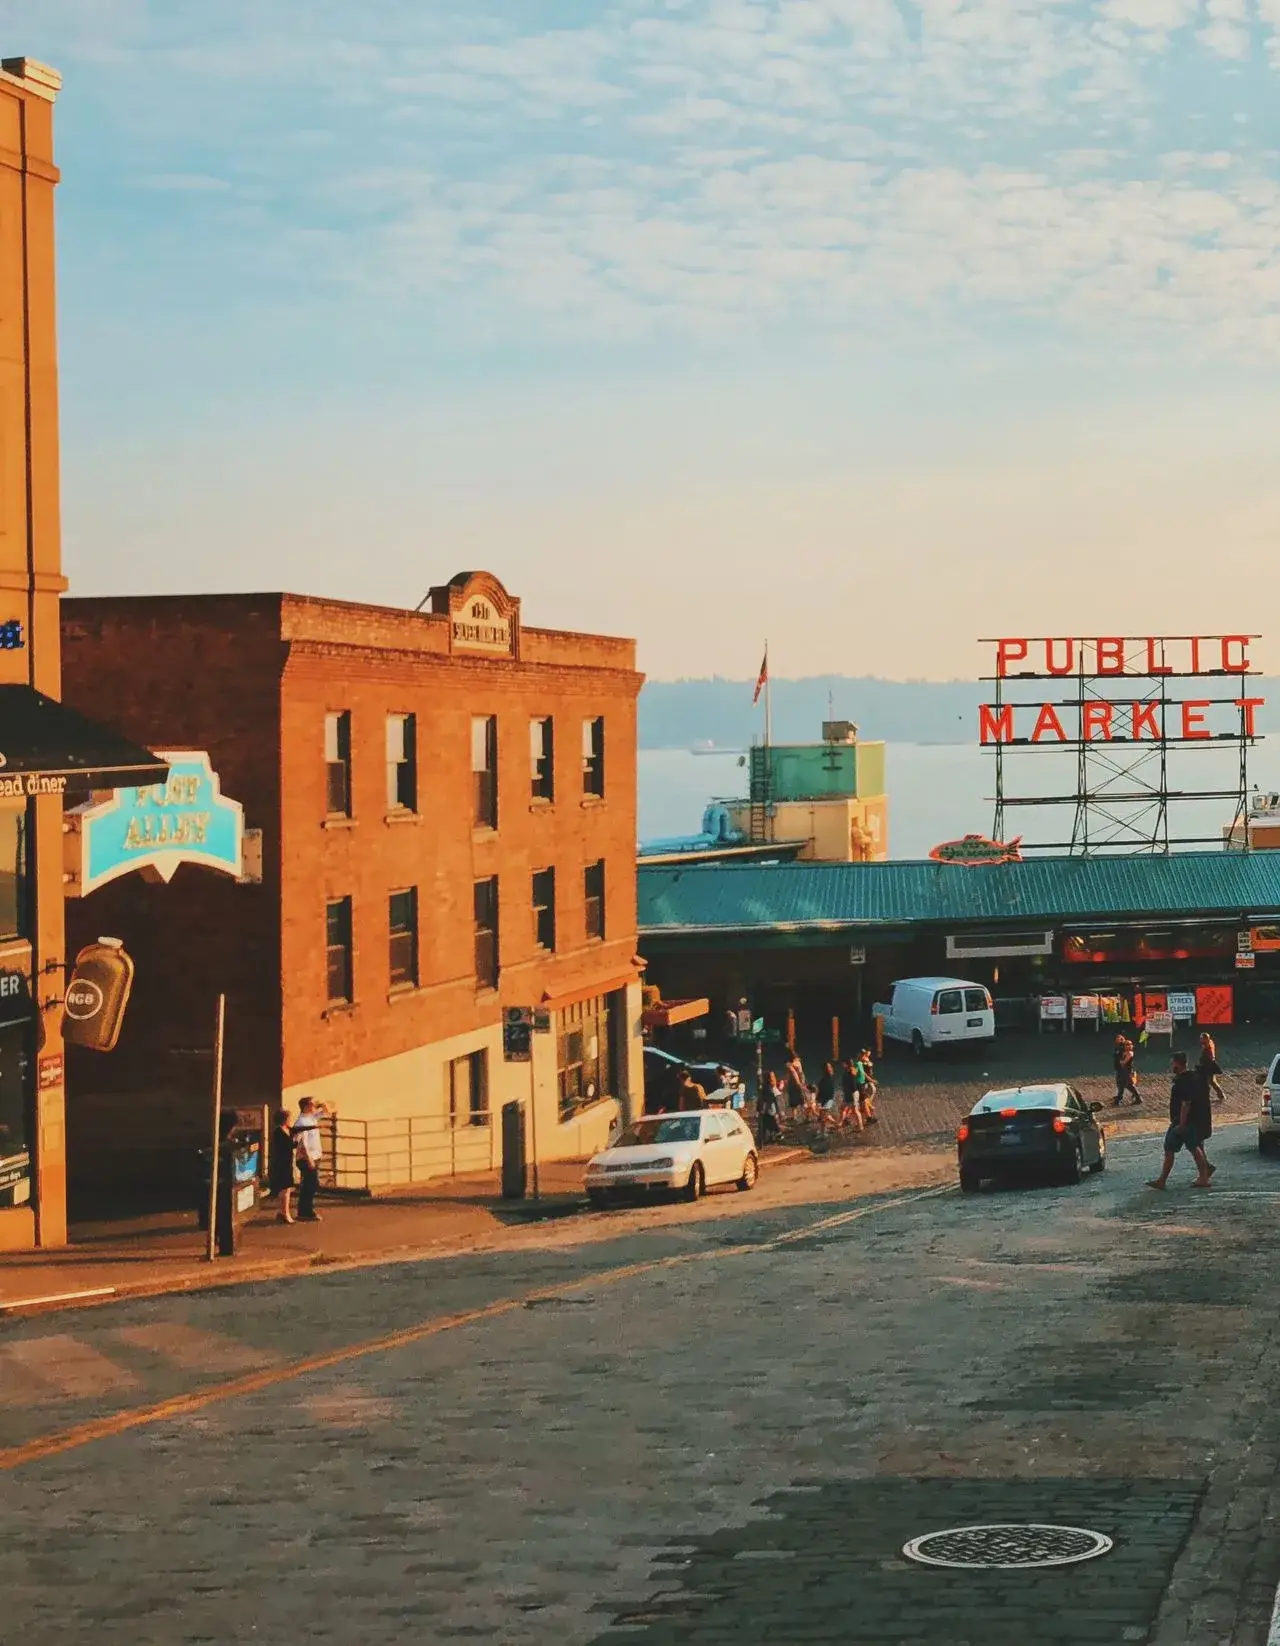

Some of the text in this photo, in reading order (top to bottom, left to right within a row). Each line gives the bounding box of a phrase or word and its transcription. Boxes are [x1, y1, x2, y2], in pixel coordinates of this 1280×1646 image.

[998, 636, 1250, 677] PUBLIC
[979, 698, 1265, 742] MARKET
[27, 773, 67, 795] diner
[123, 811, 210, 849] ALLEY
